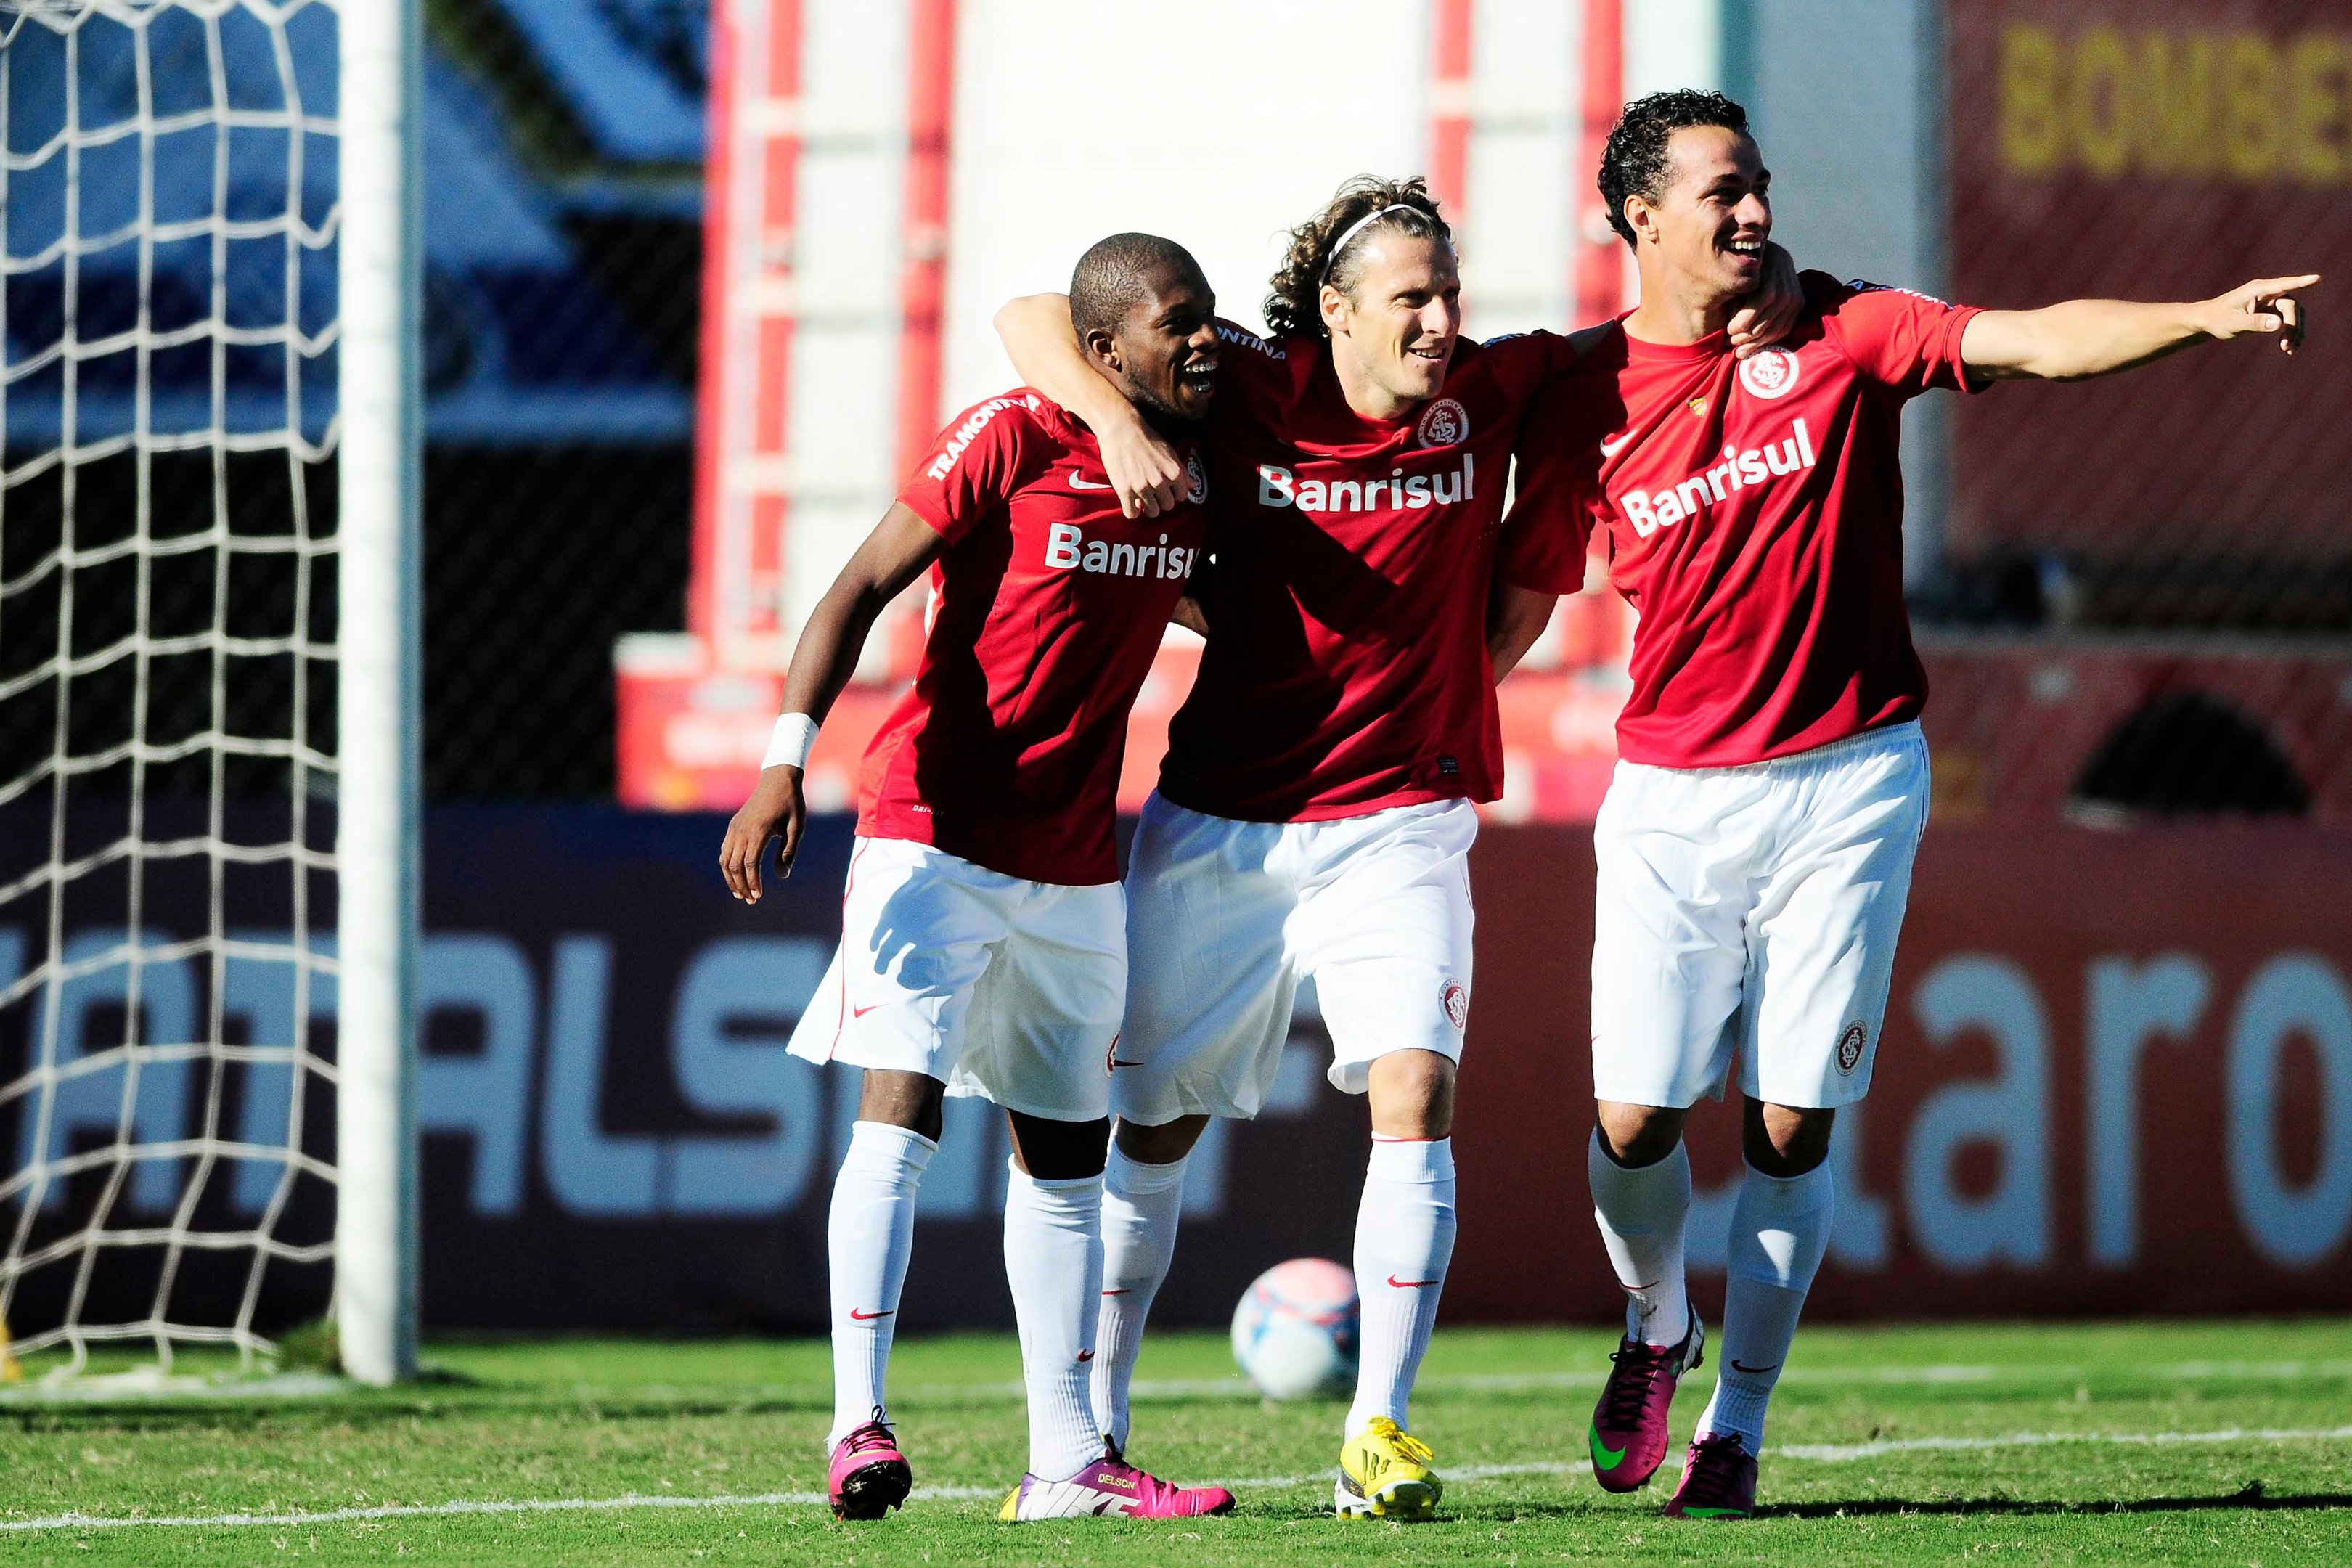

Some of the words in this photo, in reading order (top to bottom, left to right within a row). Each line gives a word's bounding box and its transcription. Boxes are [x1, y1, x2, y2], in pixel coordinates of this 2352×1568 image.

[1217, 326, 1286, 359] NTINA
[1259, 453, 1474, 512] Banrisul
[1620, 418, 1816, 538] Banrisul
[1683, 951, 2352, 1275] aro
[1098, 1473, 1135, 1490] DELSON
